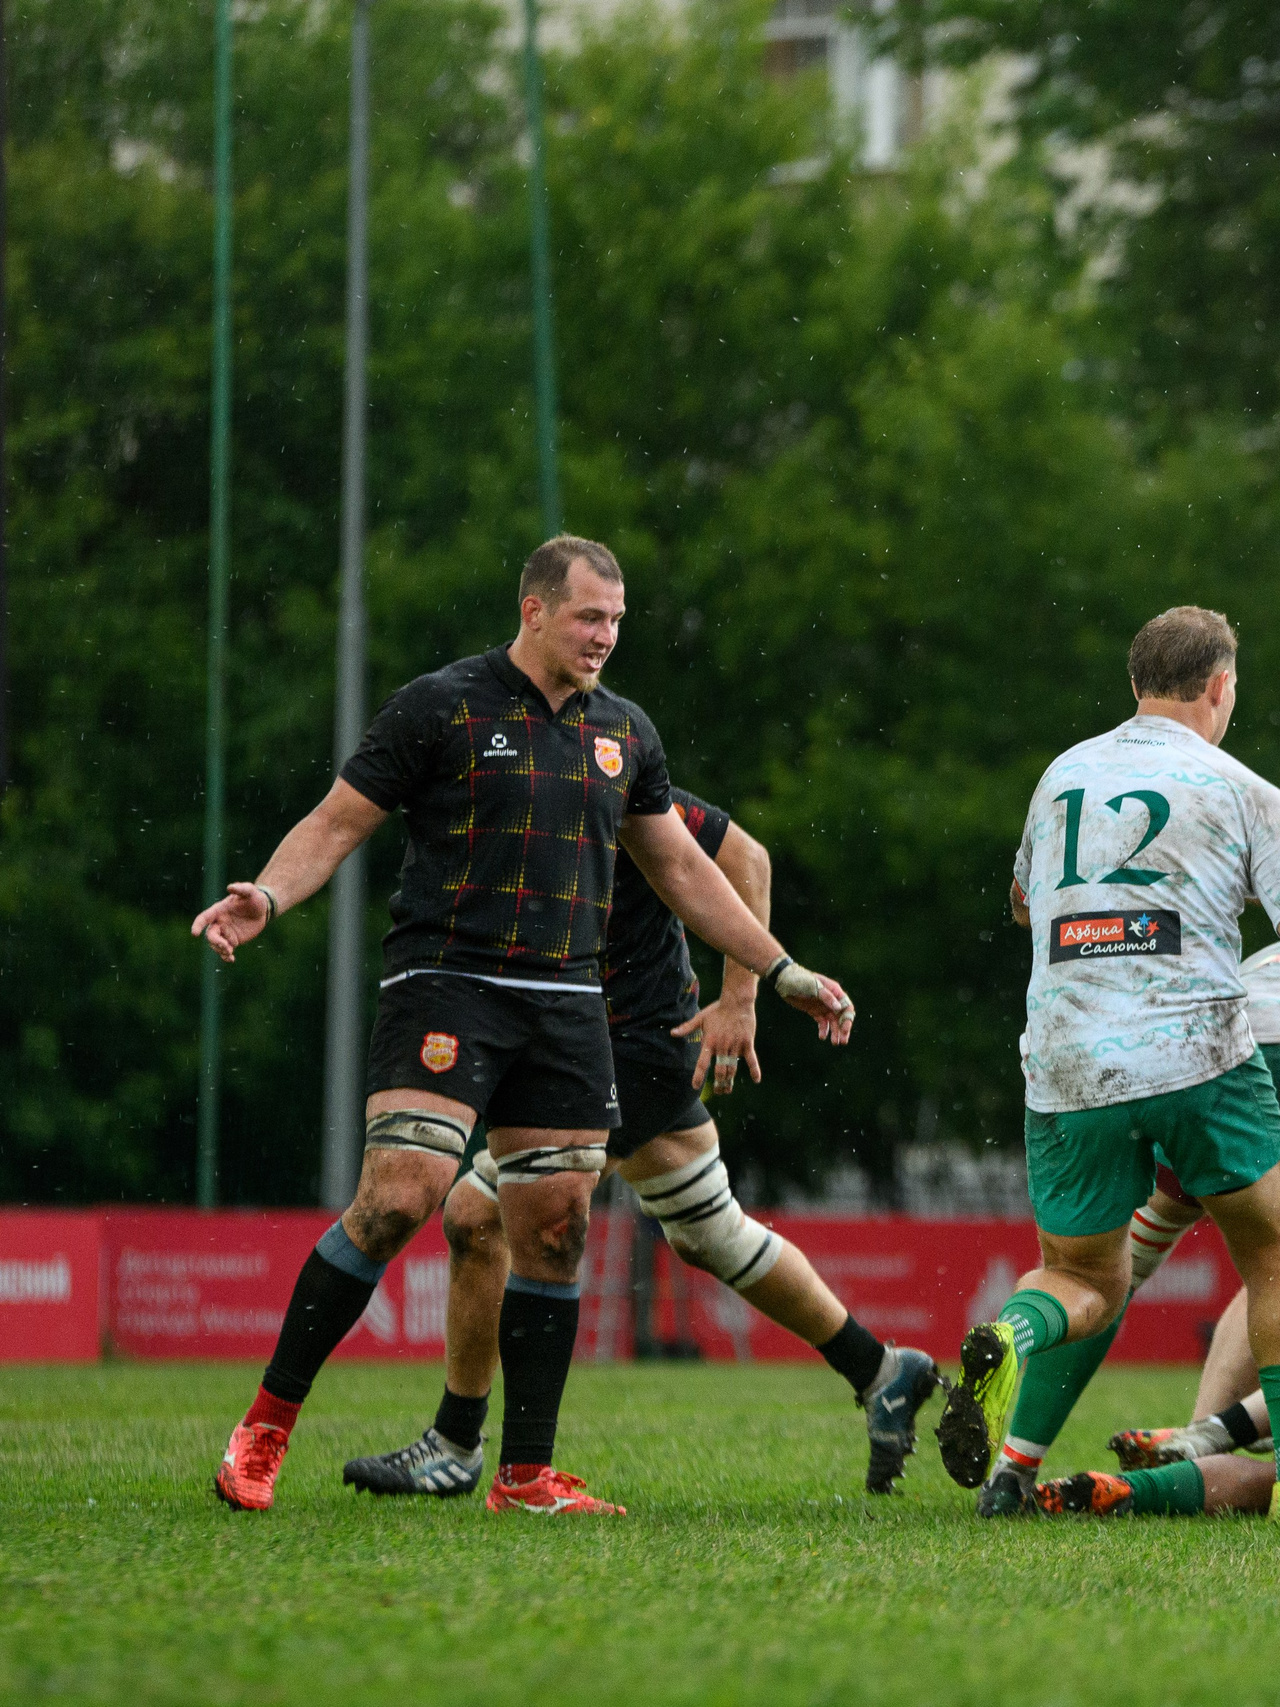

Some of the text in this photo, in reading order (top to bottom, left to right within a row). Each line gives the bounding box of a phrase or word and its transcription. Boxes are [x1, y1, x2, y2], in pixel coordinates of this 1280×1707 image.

[1116, 738, 1166, 747] centurion
[483, 748, 518, 757] centurion
[1052, 788, 1172, 891] 12
[1064, 924, 1122, 940] Азбука
[1080, 939, 1157, 955] Салютов
